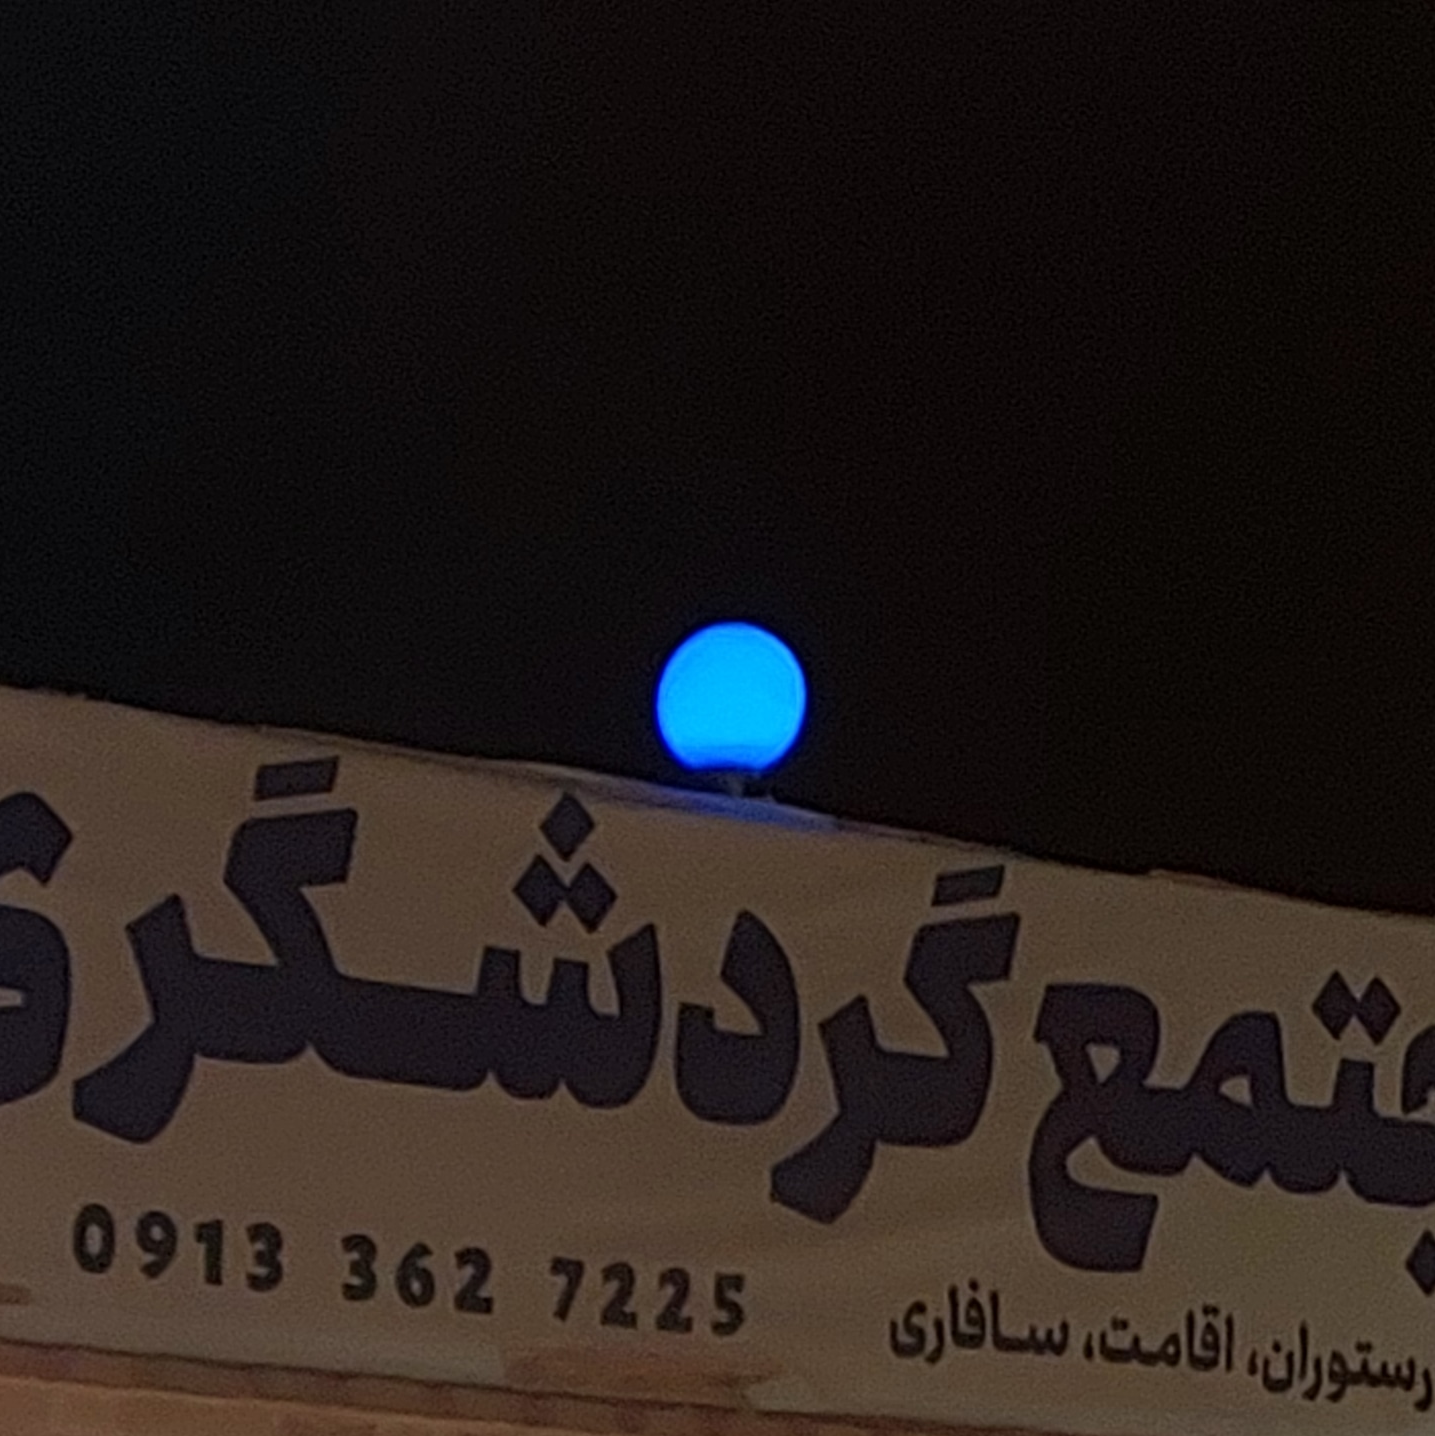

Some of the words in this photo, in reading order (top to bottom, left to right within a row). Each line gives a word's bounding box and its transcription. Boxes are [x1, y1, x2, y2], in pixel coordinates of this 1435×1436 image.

[72, 1203, 285, 1293] 0913
[340, 1233, 495, 1315] 362
[549, 1256, 747, 1336] 7225
[889, 1278, 1071, 1364] سافاری
